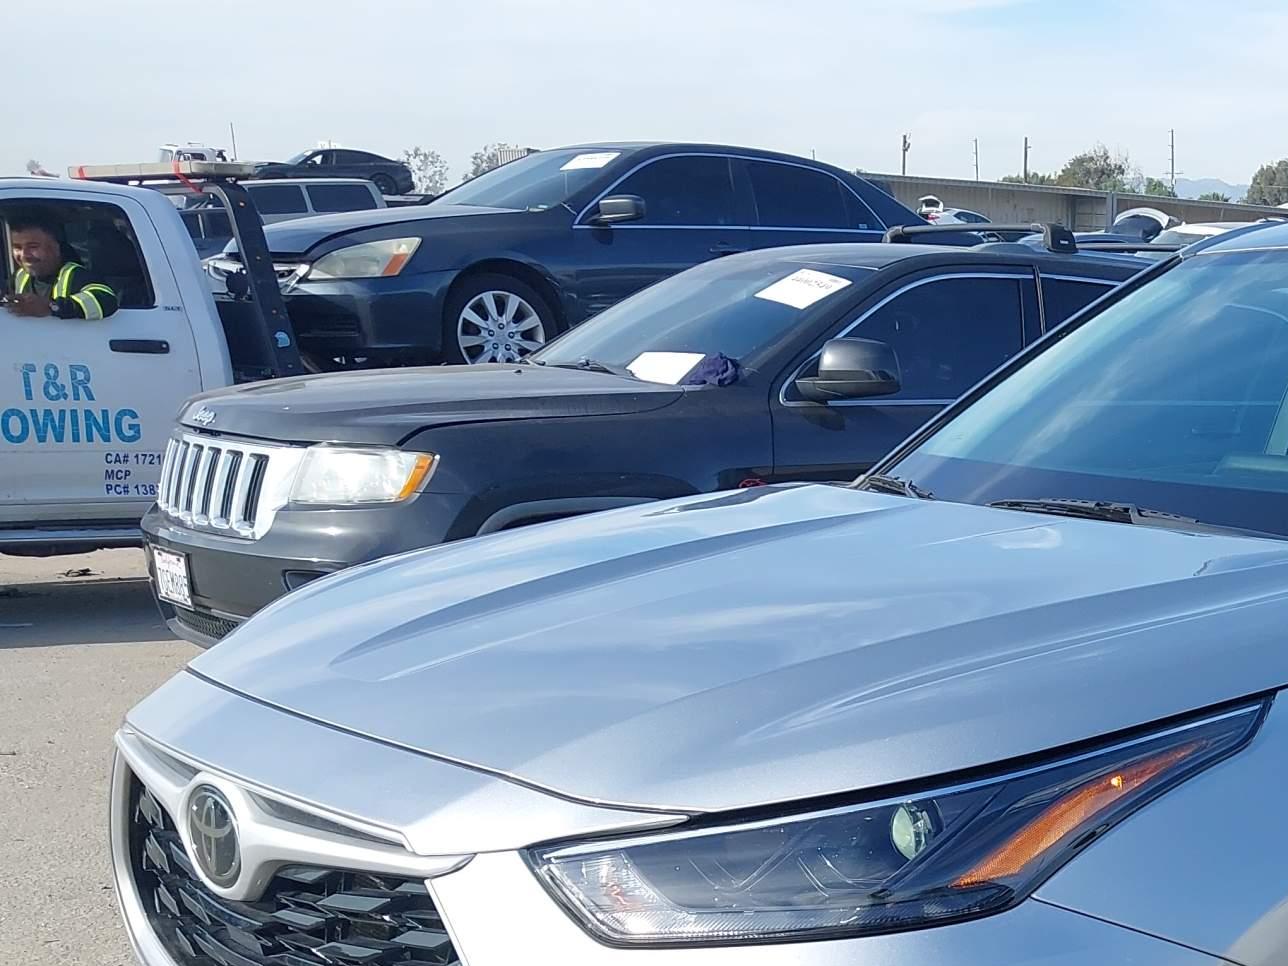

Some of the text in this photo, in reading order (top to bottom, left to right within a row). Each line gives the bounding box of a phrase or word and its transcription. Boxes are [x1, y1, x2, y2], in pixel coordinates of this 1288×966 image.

[20, 363, 96, 401] T&R
[0, 408, 142, 444] OWING
[105, 453, 165, 466] CA# 1721
[105, 469, 131, 481] MCP
[105, 484, 130, 496] PC#
